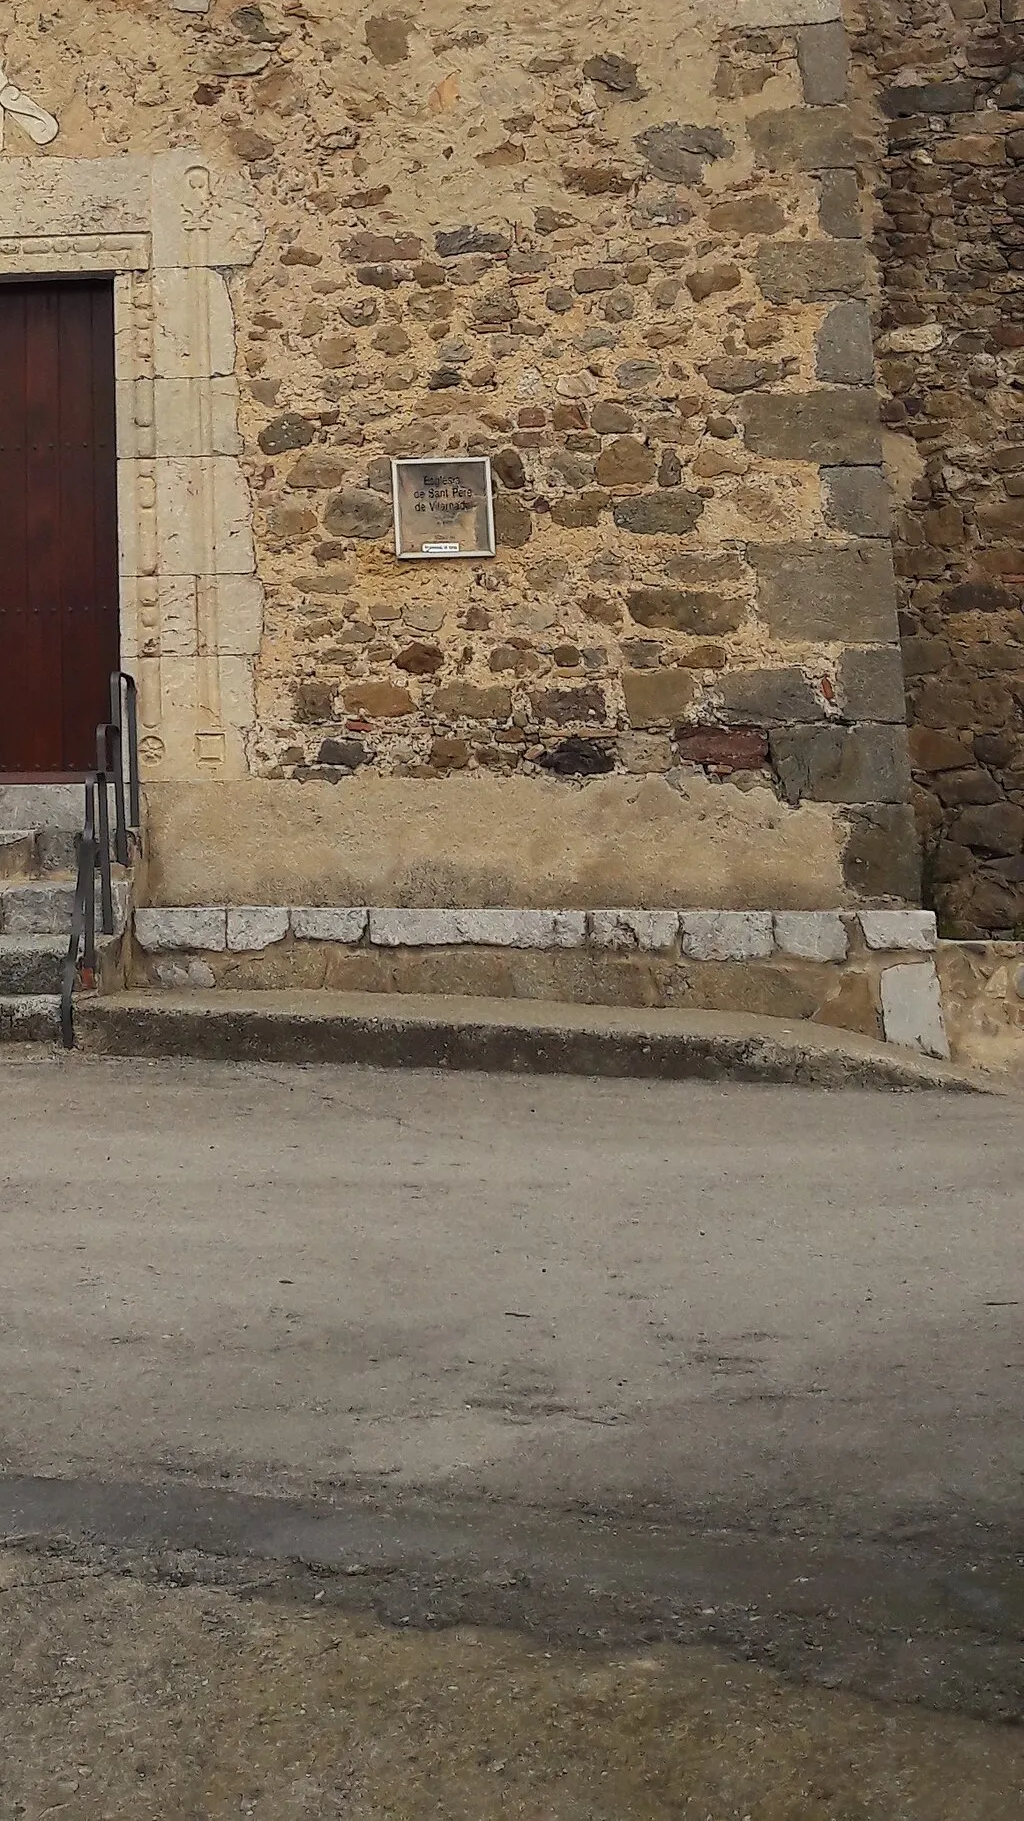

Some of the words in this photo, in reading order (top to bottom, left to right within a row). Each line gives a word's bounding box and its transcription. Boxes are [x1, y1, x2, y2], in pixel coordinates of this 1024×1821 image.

[413, 489, 426, 499] de
[428, 488, 449, 499] Sant
[452, 487, 473, 498] Pere
[414, 501, 426, 512] de
